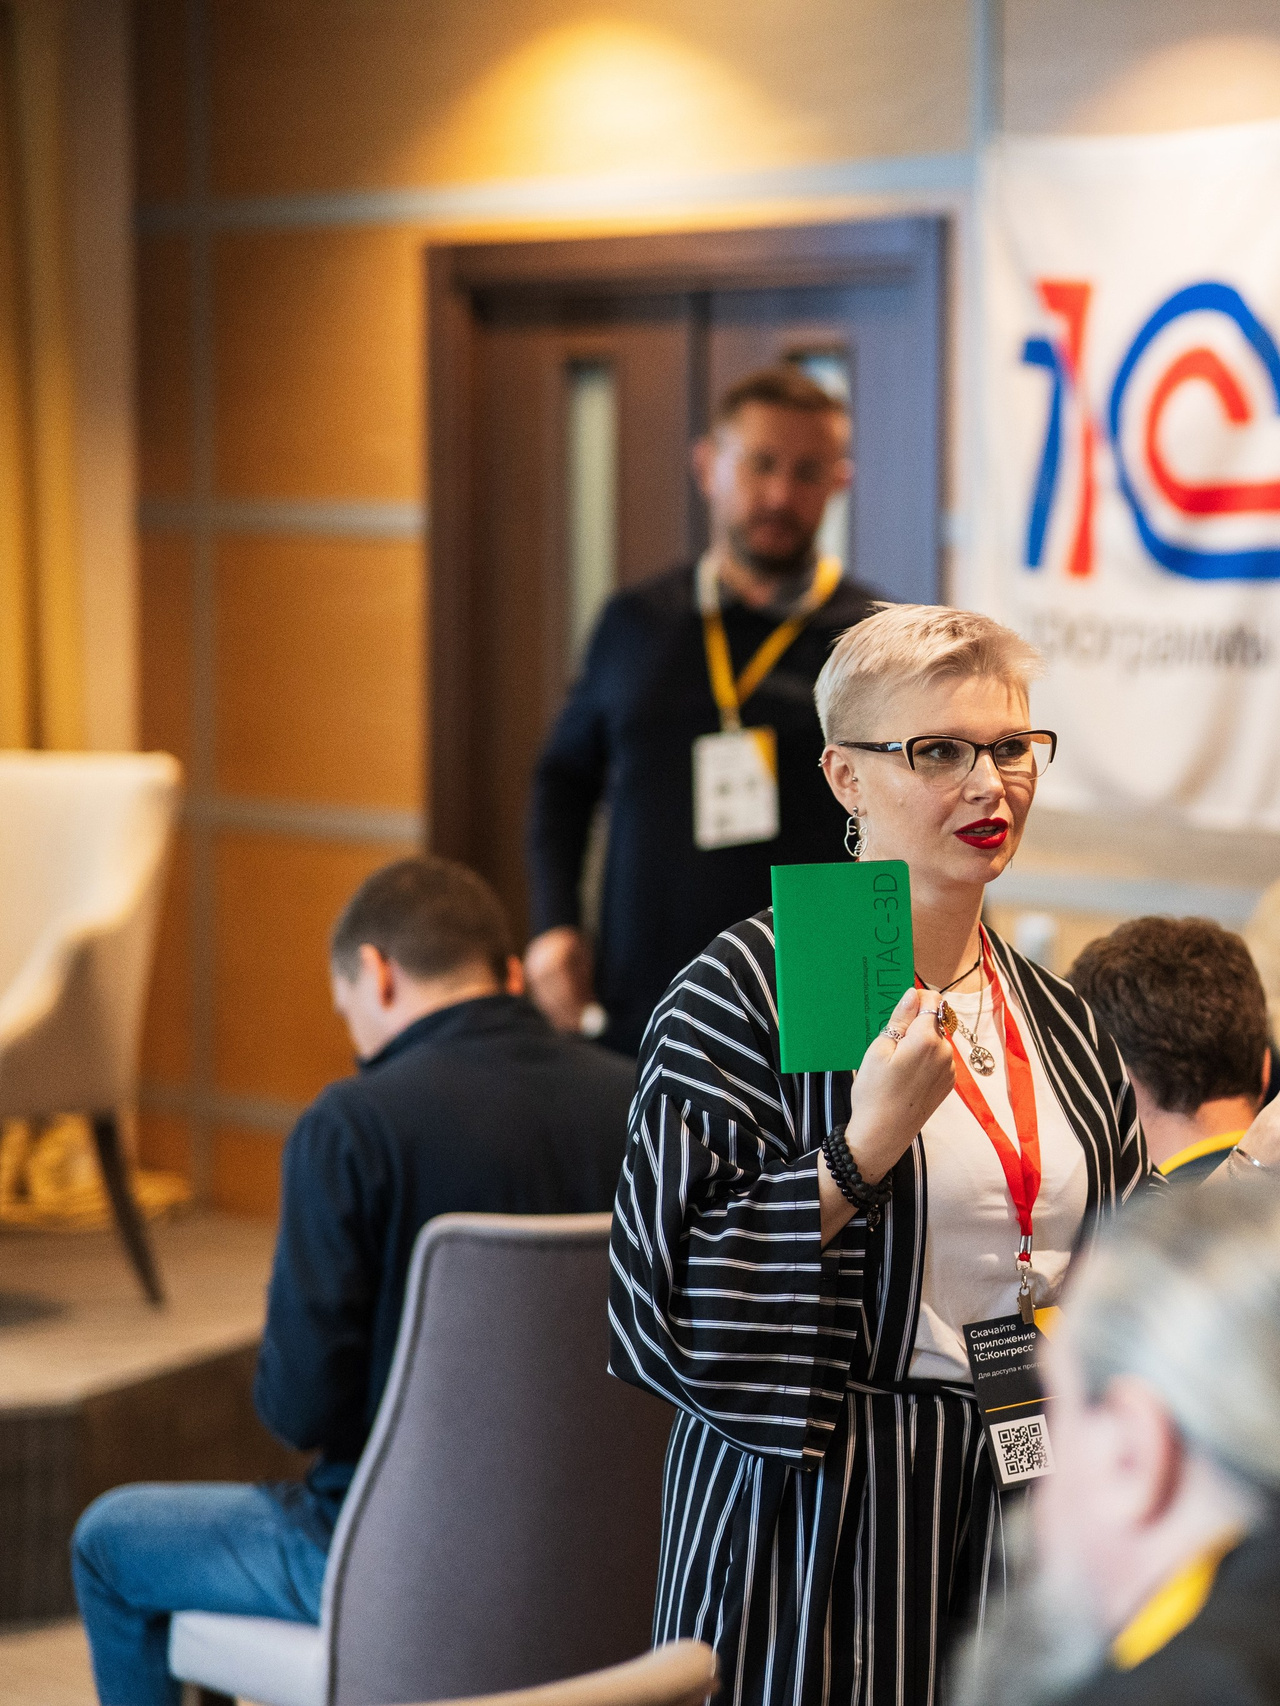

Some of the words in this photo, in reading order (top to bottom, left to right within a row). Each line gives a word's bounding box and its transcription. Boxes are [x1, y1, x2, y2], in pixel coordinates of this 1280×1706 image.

[970, 1323, 1017, 1339] Скачайте
[972, 1331, 1037, 1351] приложение
[974, 1344, 1034, 1363] 1С:Конгресс
[978, 1372, 990, 1380] Для
[991, 1366, 1017, 1377] доступа
